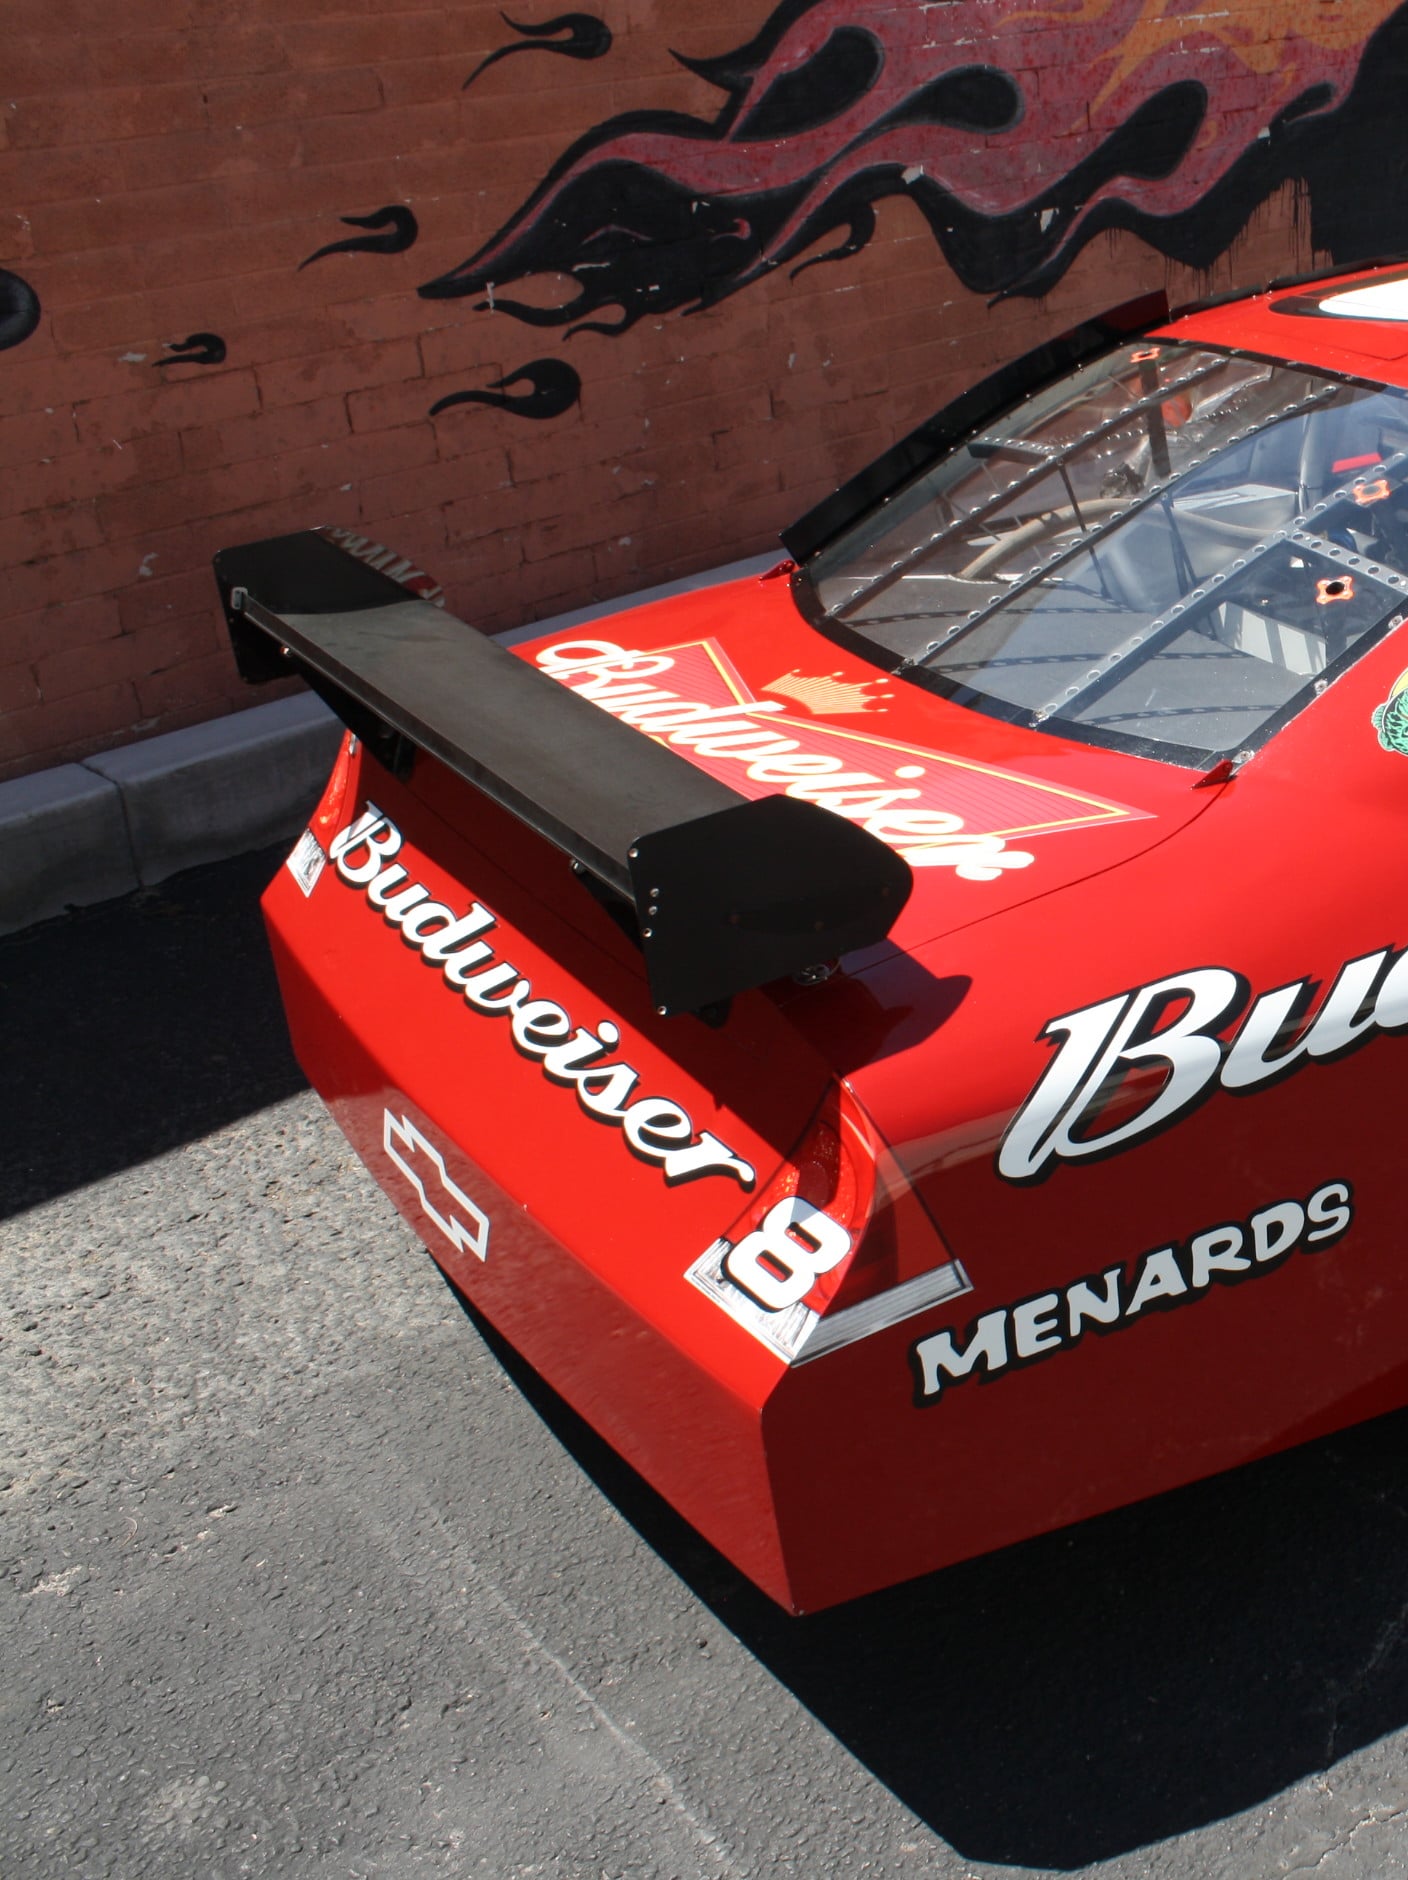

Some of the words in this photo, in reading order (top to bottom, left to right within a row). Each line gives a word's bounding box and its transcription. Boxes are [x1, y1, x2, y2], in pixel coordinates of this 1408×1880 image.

[535, 639, 1036, 881] Budweiser
[328, 801, 757, 1192] Budweiser
[722, 1195, 852, 1311] 8
[915, 1183, 1353, 1398] MENARDS
